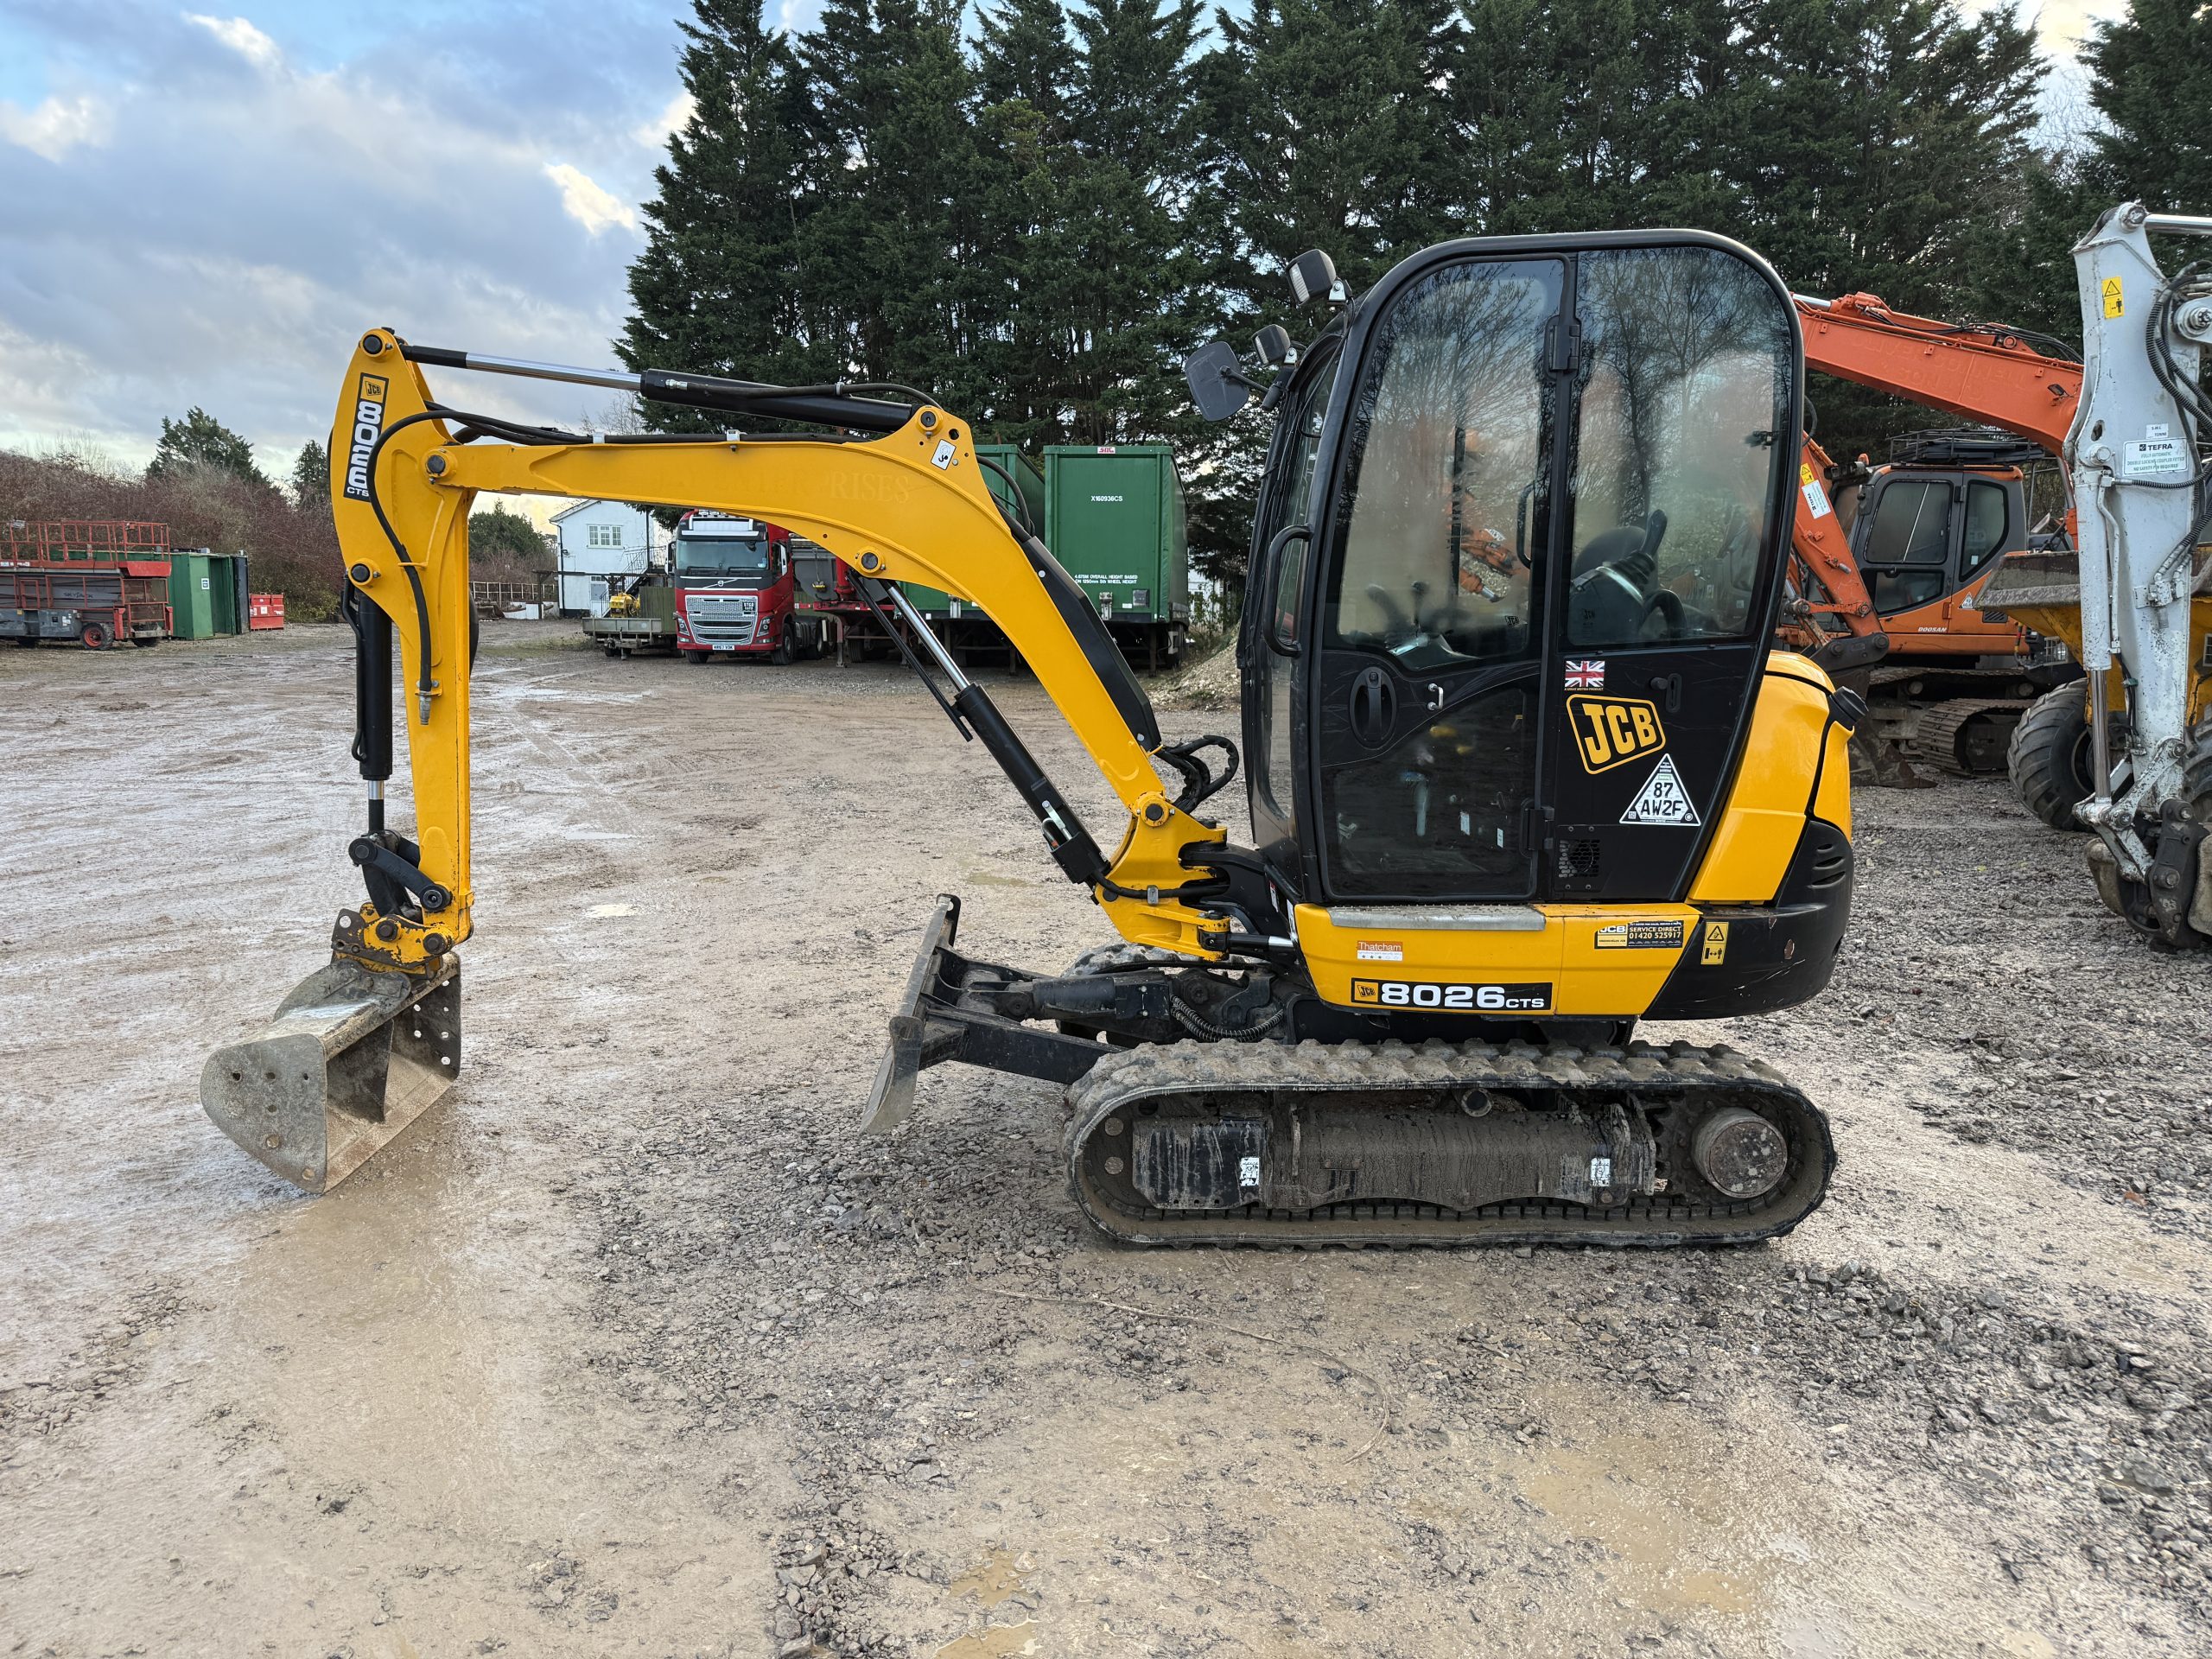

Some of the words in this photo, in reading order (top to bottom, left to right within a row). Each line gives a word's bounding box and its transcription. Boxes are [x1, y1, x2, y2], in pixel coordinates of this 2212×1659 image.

[367, 383, 381, 395] JCB
[348, 401, 383, 490] 8026
[347, 486, 369, 497] CTS
[1582, 703, 1657, 765] JCB
[1654, 782, 1674, 798] 87
[1641, 799, 1683, 816] AW2F
[1358, 941, 1402, 951] Thatcham
[1361, 985, 1375, 997] JCB
[1381, 982, 1505, 1008] 8026
[1505, 998, 1545, 1008] CTS
